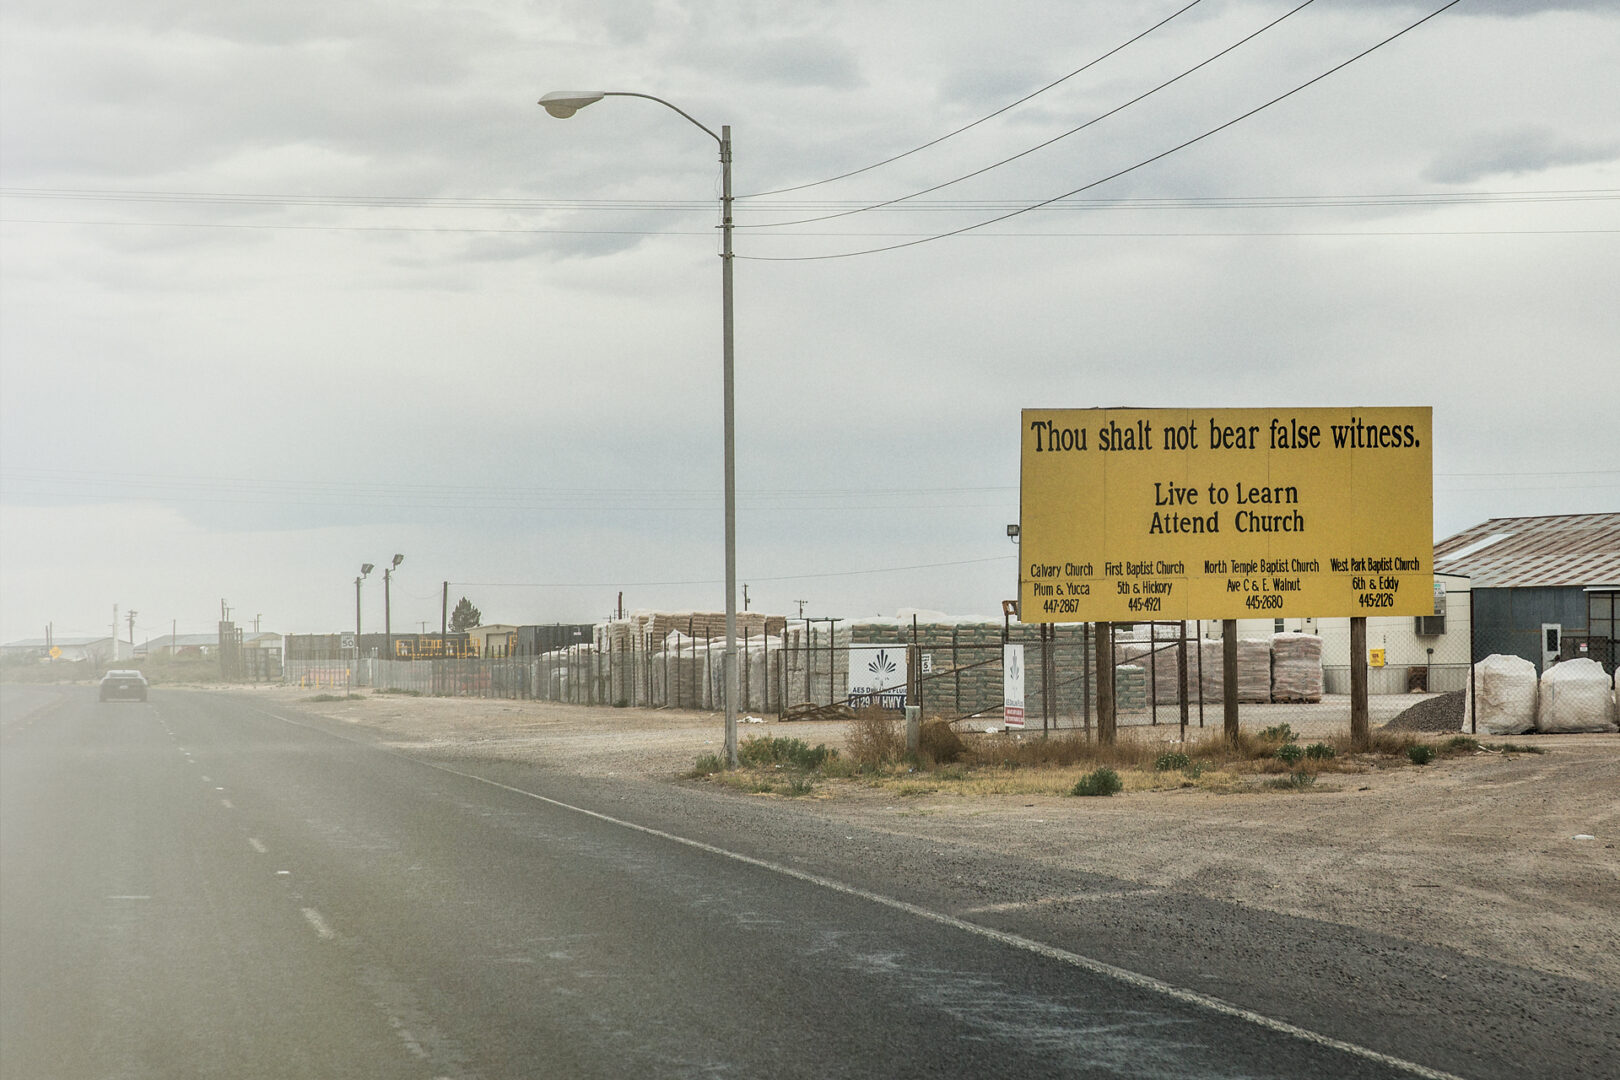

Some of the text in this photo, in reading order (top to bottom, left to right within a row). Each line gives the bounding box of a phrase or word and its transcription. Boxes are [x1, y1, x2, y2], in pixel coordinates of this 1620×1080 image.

[1031, 417, 1420, 452] Thou shalt not bear false witness.
[1154, 481, 1298, 506] Live to Learn
[1149, 509, 1304, 534] Attend Church
[1031, 562, 1093, 578] Calvary Church
[1105, 561, 1184, 578] First Baptist Church
[1205, 559, 1319, 576] North Temple Baptist Church
[1330, 557, 1419, 573] West Park Baptist Church
[1034, 583, 1090, 596] Plum & Yucca
[1118, 581, 1172, 595] 5th & Hickory
[1227, 579, 1240, 592] Ave
[1243, 579, 1249, 591] C
[1252, 581, 1259, 591] &
[1273, 578, 1301, 591] Walnut
[1352, 576, 1399, 592] 6th & Eddy
[882, 696, 901, 709] HWY
